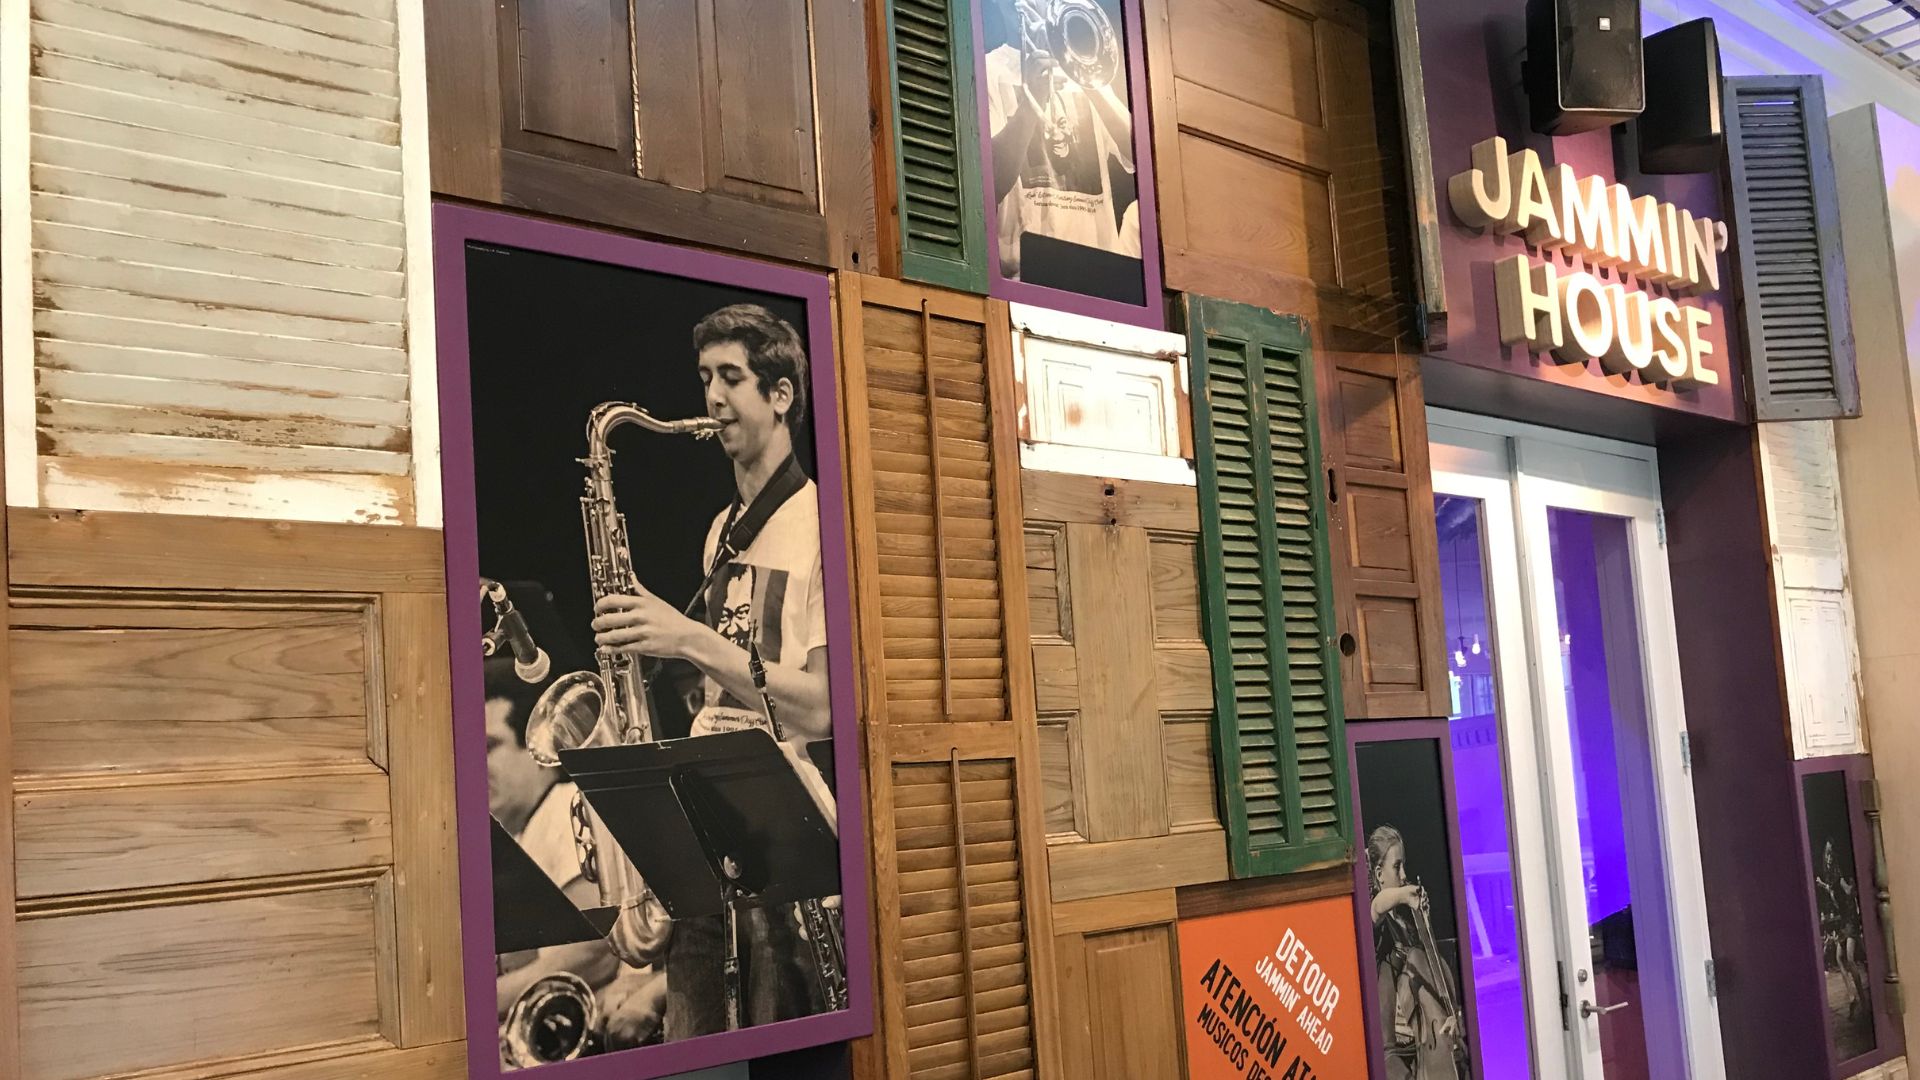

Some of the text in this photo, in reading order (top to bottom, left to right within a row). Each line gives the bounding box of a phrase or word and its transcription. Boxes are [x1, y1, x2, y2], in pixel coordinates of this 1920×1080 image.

[1516, 253, 1720, 385] HOUSE
[1200, 958, 1318, 1080] ATENCIÓN AT
[1275, 927, 1340, 1021] DETOUR
[1196, 1003, 1249, 1071] MUSICOS
[1296, 1005, 1333, 1055] AHEAD
